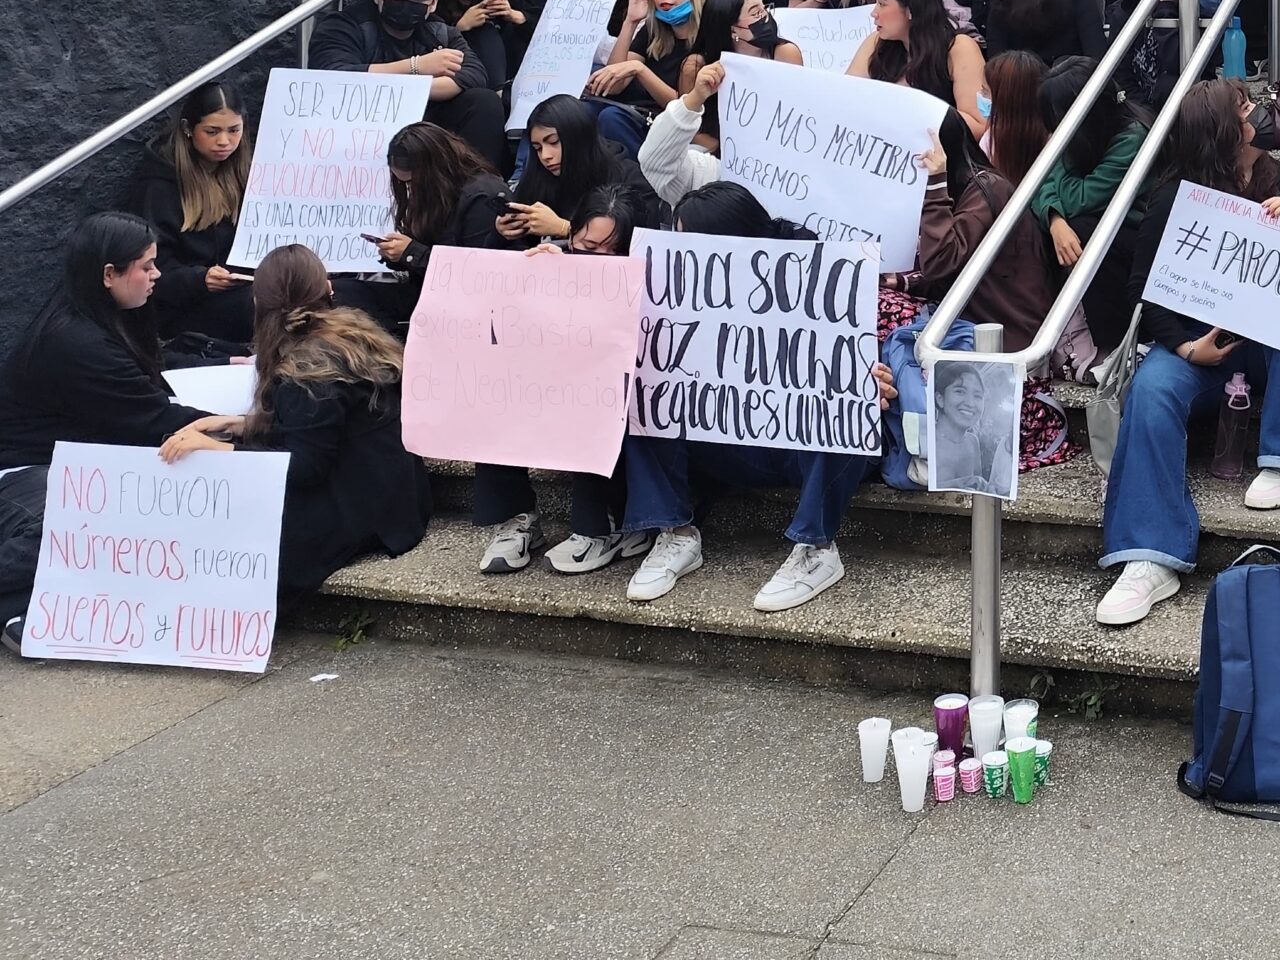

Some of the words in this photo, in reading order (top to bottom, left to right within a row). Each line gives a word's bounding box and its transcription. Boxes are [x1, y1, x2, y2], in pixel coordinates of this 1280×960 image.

[284, 81, 323, 120] SER
[332, 82, 403, 123] JOVEN
[279, 127, 296, 160] Y
[301, 130, 337, 160] NO
[727, 81, 759, 128] NO
[823, 124, 922, 186] MENTIRAS
[725, 136, 811, 201] QUEREMOS
[243, 200, 263, 229] ES
[265, 201, 295, 229] UNA
[462, 251, 592, 301] Comunidad
[602, 263, 644, 309] UV
[411, 363, 441, 402] de
[717, 322, 879, 400] muchas
[636, 370, 780, 441] regiones
[785, 392, 881, 452] unidas
[62, 466, 108, 515] NO
[153, 615, 174, 642] y
